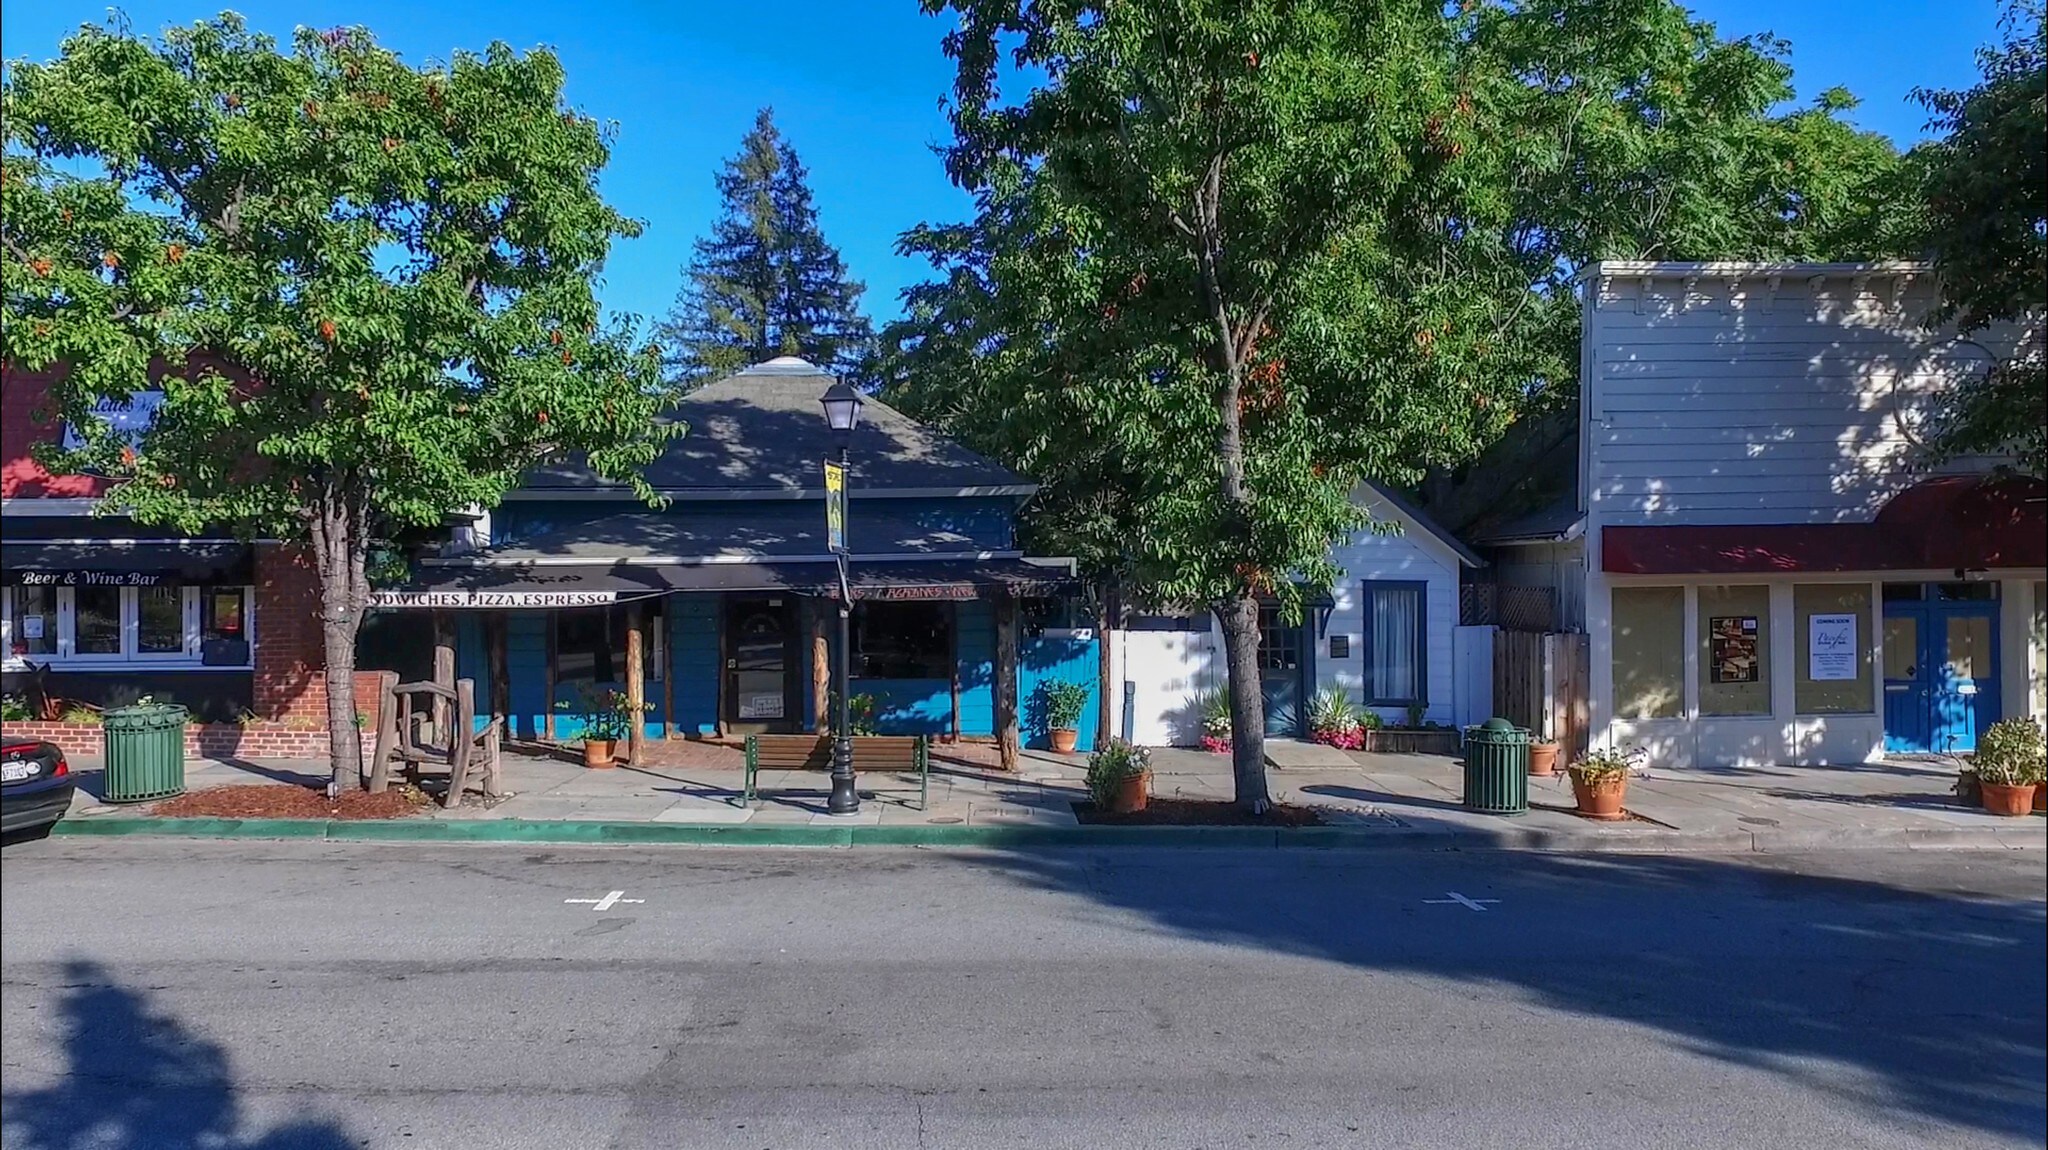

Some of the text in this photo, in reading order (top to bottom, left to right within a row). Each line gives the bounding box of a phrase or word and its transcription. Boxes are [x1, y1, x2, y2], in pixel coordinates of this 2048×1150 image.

[21, 570, 160, 586] Beer & Wine Bar
[366, 593, 465, 606] NDWICHES,
[523, 594, 608, 606] ESPRESSO
